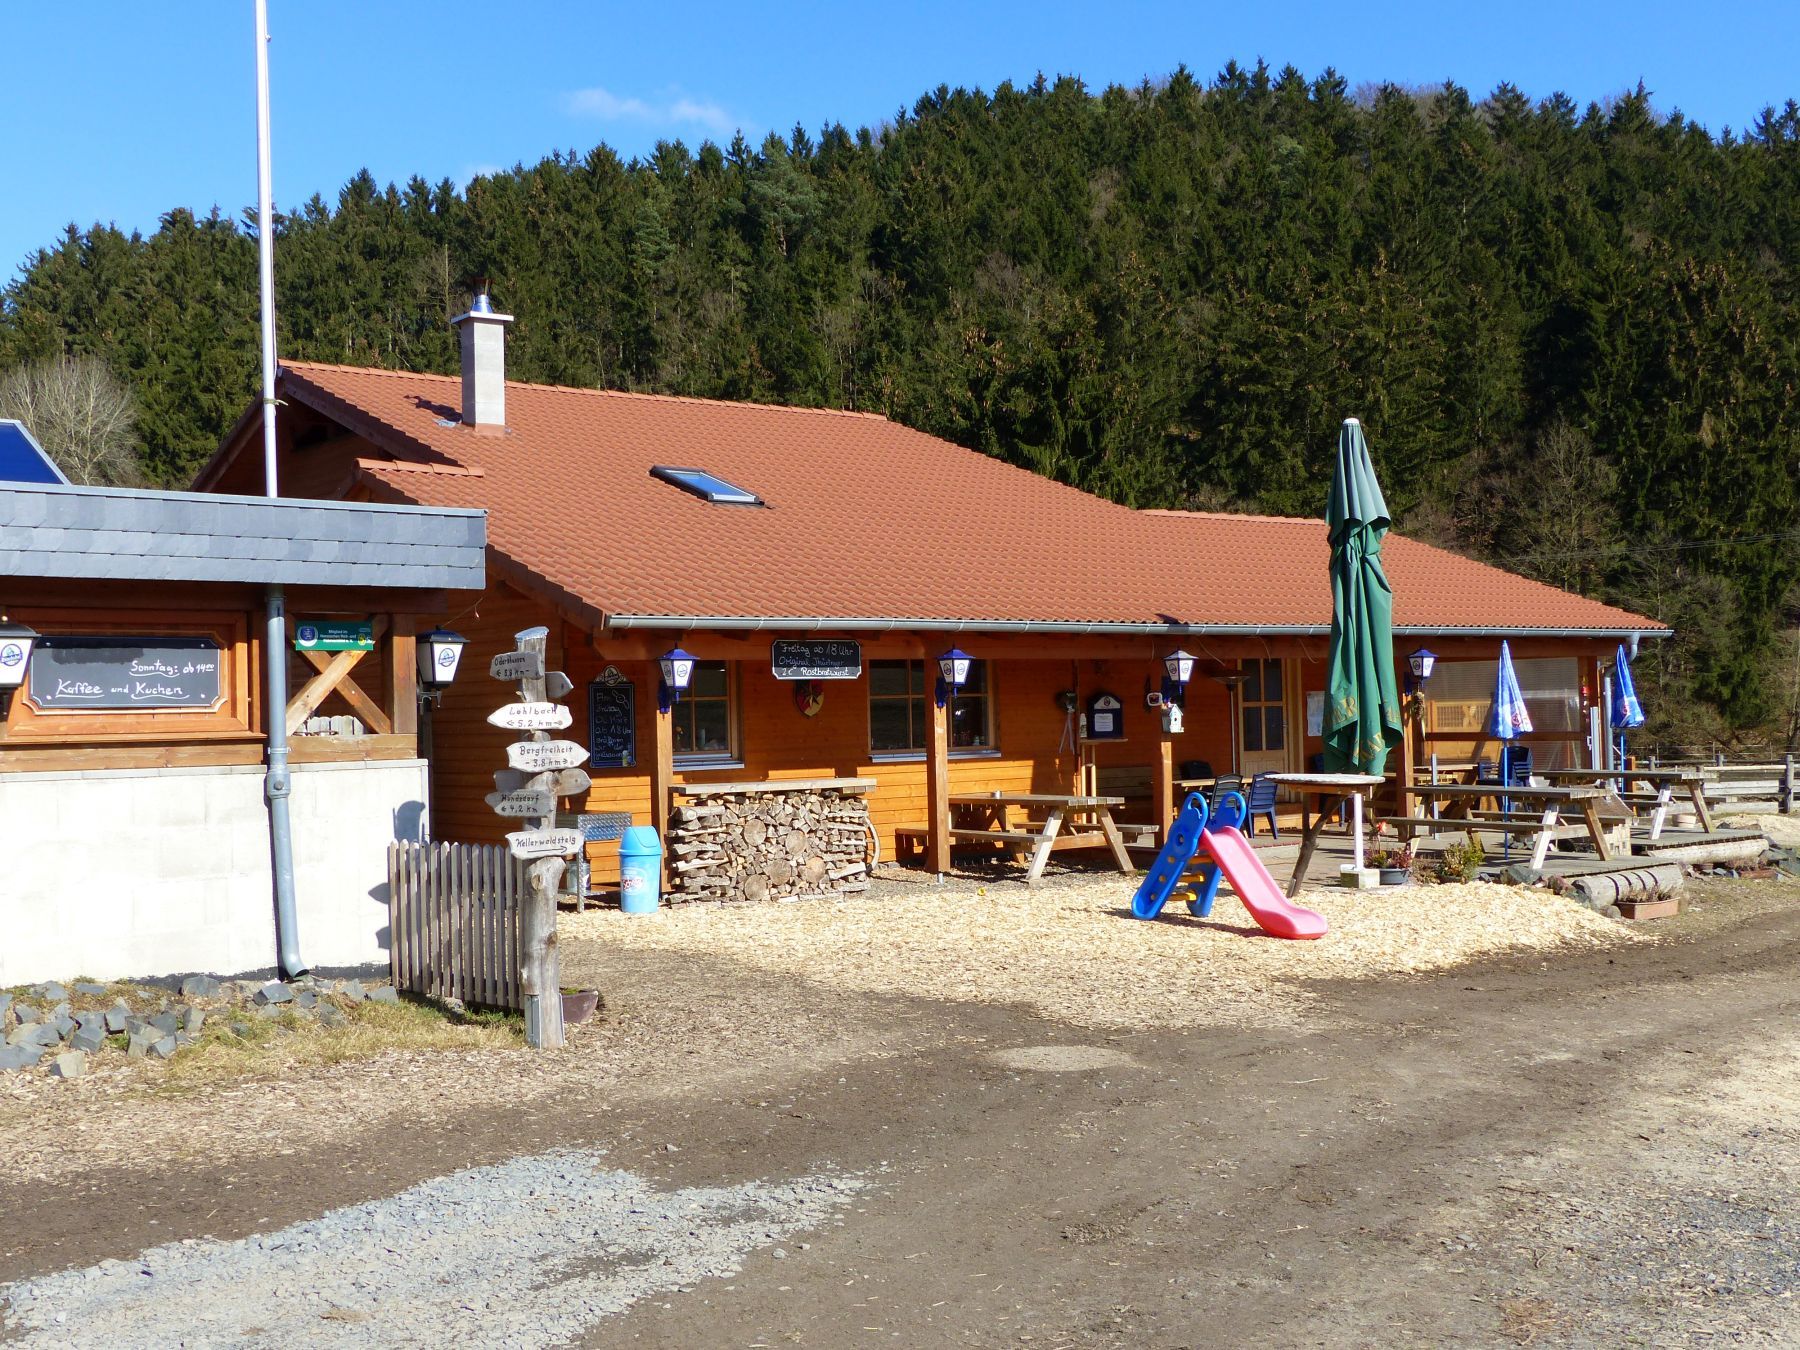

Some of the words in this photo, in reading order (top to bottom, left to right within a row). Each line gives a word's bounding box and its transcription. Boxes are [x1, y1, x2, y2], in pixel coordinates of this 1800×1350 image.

[782, 644, 810, 657] Freitag
[813, 645, 824, 654] ab
[826, 643, 838, 656] 18
[838, 644, 854, 656] Uhr
[131, 659, 179, 675] Sonntag:
[183, 661, 194, 673] ab
[779, 656, 810, 670] Original
[56, 678, 103, 695] Kaffee
[110, 683, 129, 693] und
[135, 681, 182, 695] Kuchen
[520, 745, 573, 756] Bergfreiheit
[510, 804, 524, 814] 4,2
[515, 836, 577, 848] Kellerwaldsteig
